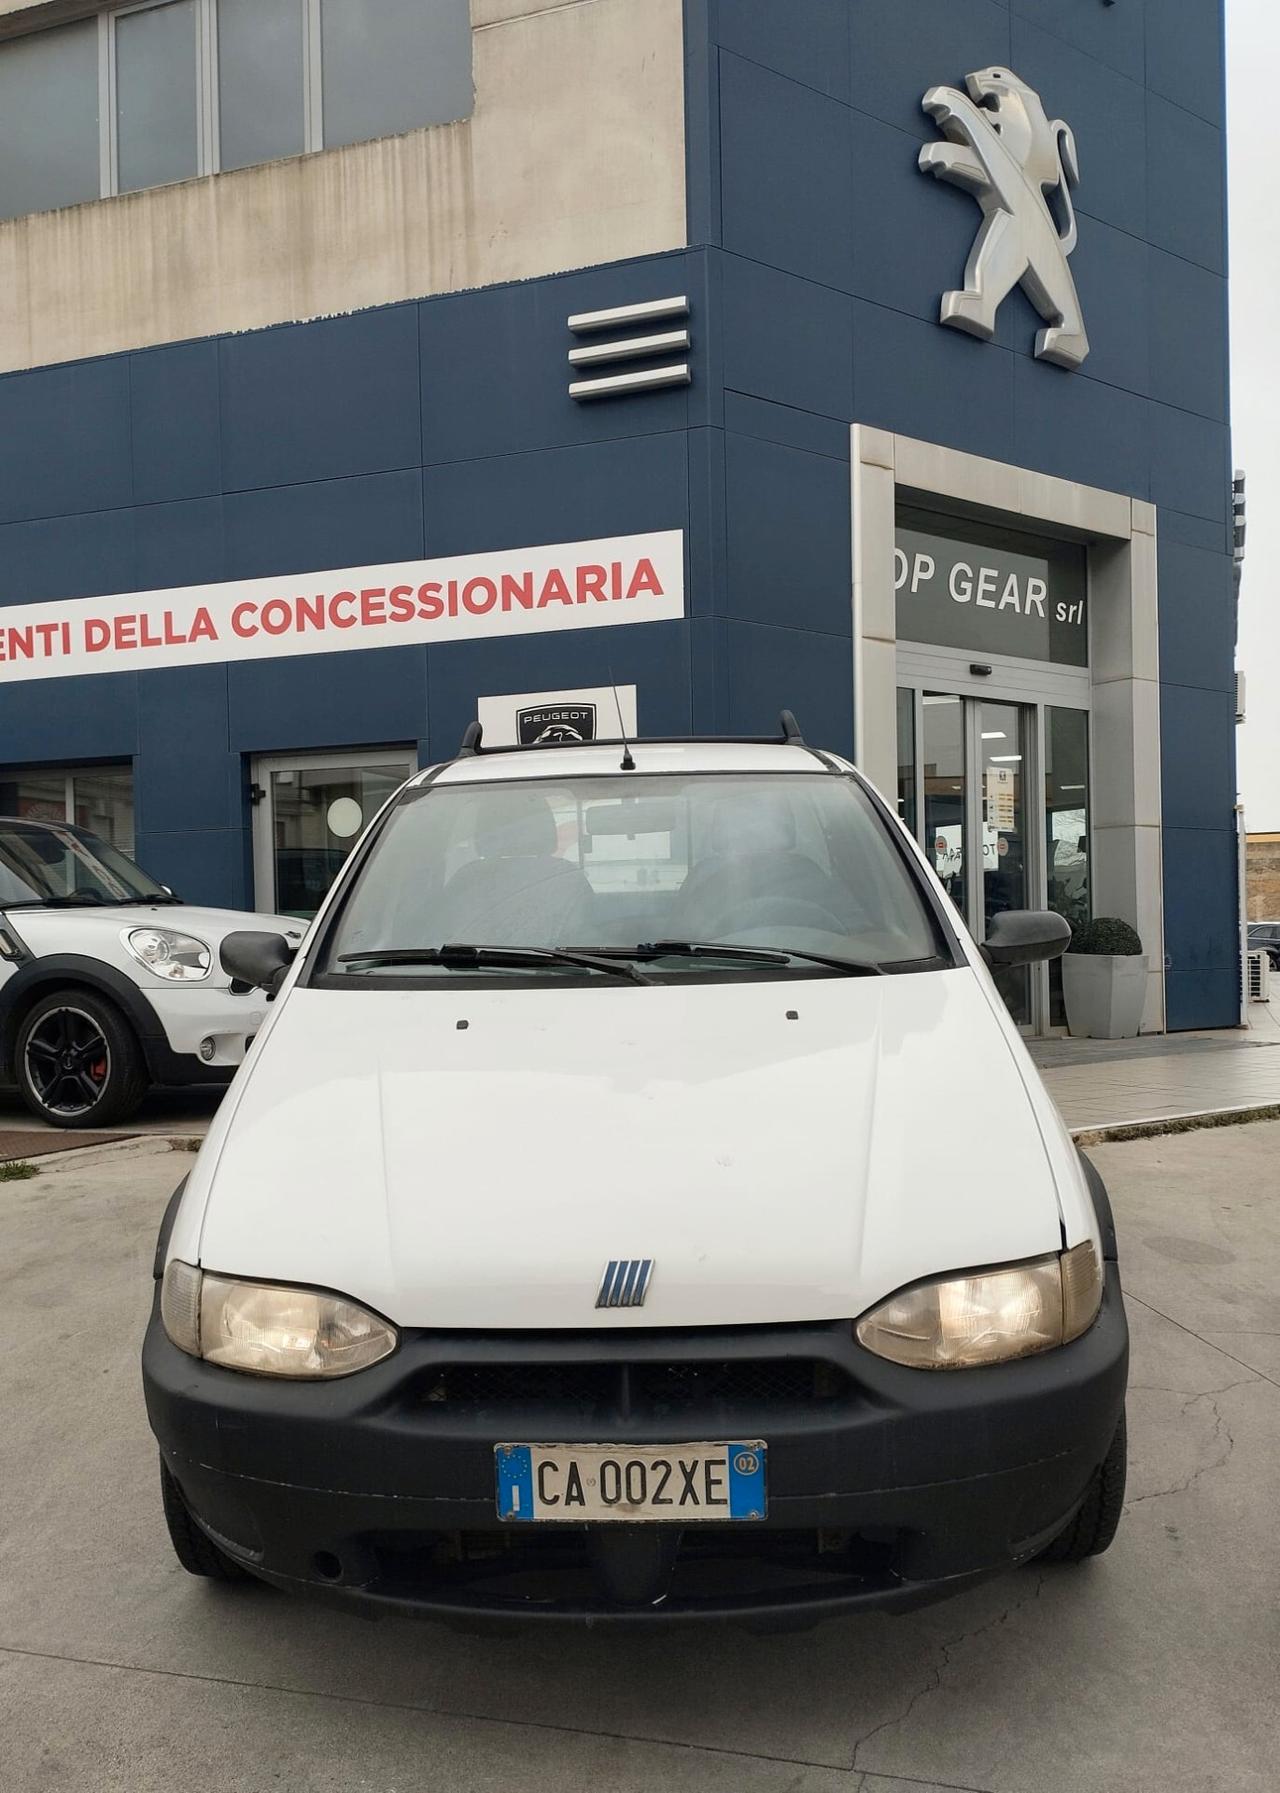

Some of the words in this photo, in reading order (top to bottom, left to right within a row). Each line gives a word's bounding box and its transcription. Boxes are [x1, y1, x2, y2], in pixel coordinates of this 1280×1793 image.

[0, 622, 71, 661] NTI
[84, 607, 218, 652] DELLA
[231, 558, 664, 638] CONCESSIONARIA
[949, 561, 1047, 618] GEAR
[1056, 599, 1083, 625] srl
[523, 711, 589, 724] PEUGEOT
[738, 1457, 756, 1472] 02
